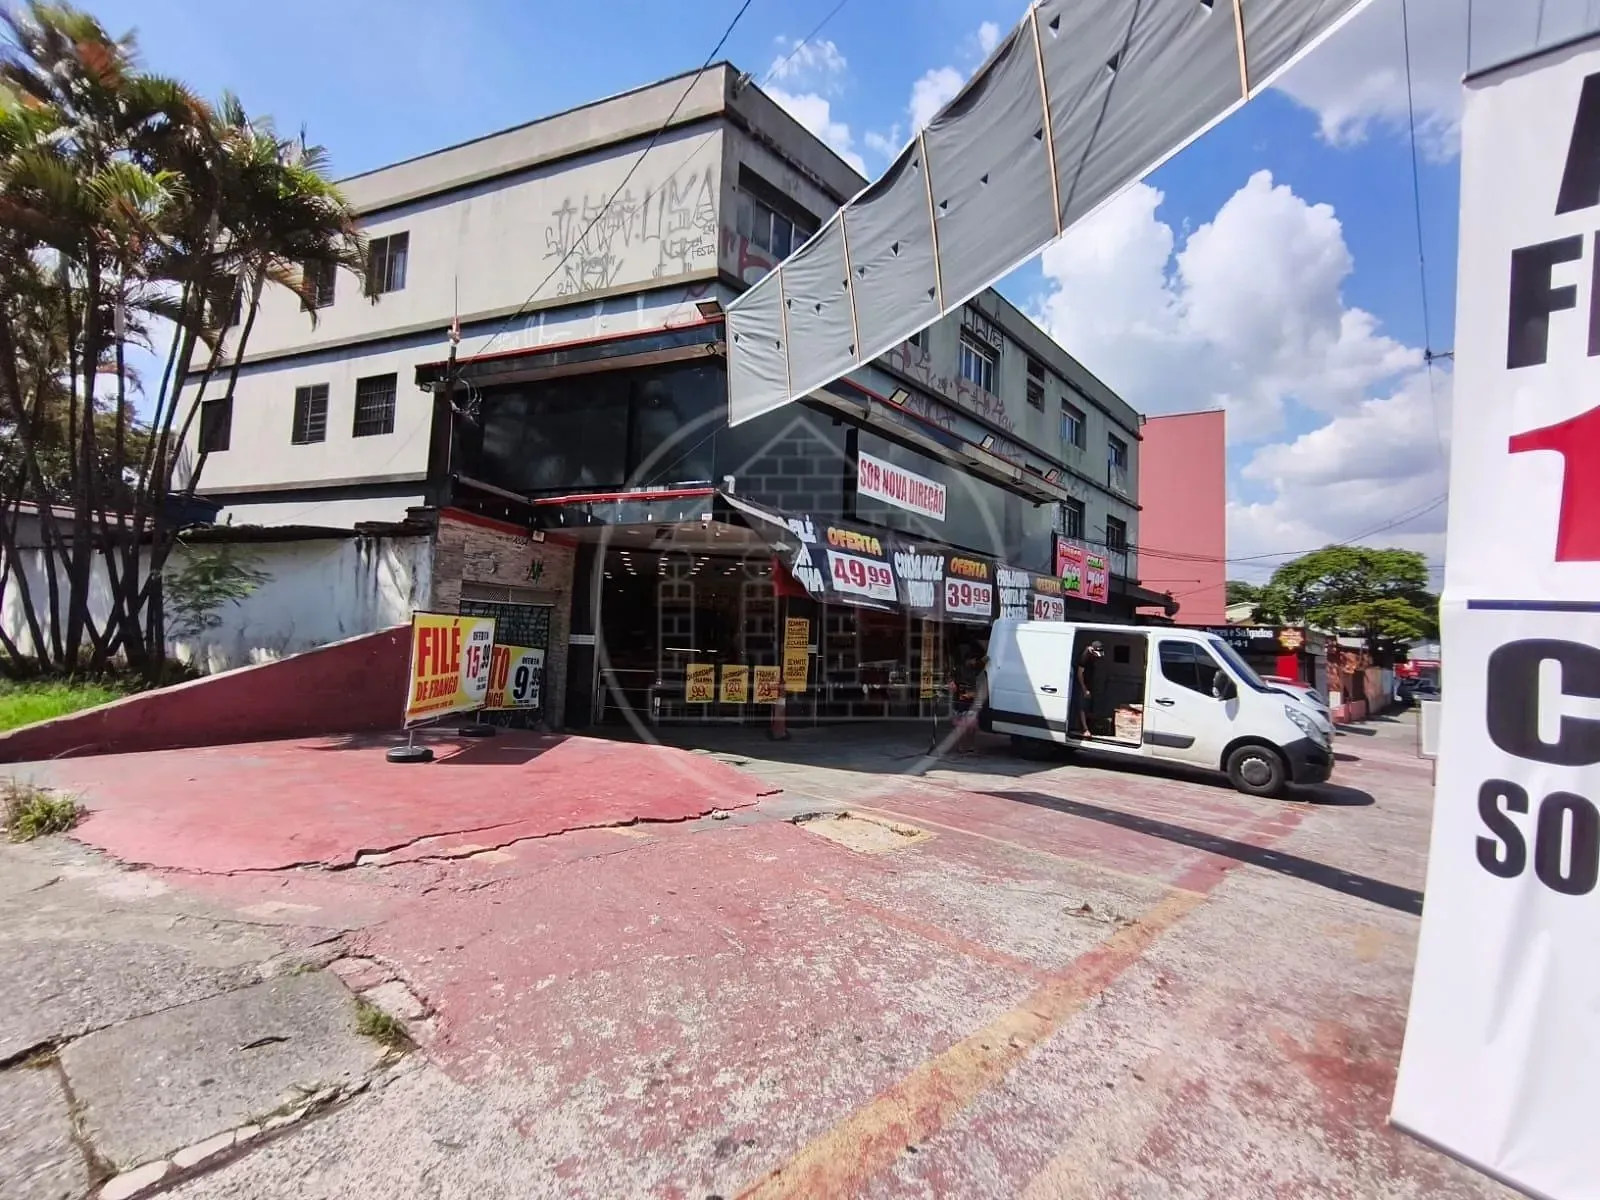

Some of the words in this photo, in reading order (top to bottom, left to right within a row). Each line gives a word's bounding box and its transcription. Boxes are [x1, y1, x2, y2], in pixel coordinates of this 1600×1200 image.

[860, 459, 881, 492] SOB
[882, 468, 907, 502] NOVA
[827, 526, 883, 557] OFERTA
[950, 556, 988, 579] OFERTA
[1036, 577, 1063, 594] OFERTA
[418, 619, 460, 676] FILÉ
[415, 681, 429, 702] DE
[429, 676, 459, 699] FRANGO
[1475, 778, 1600, 896] SO
